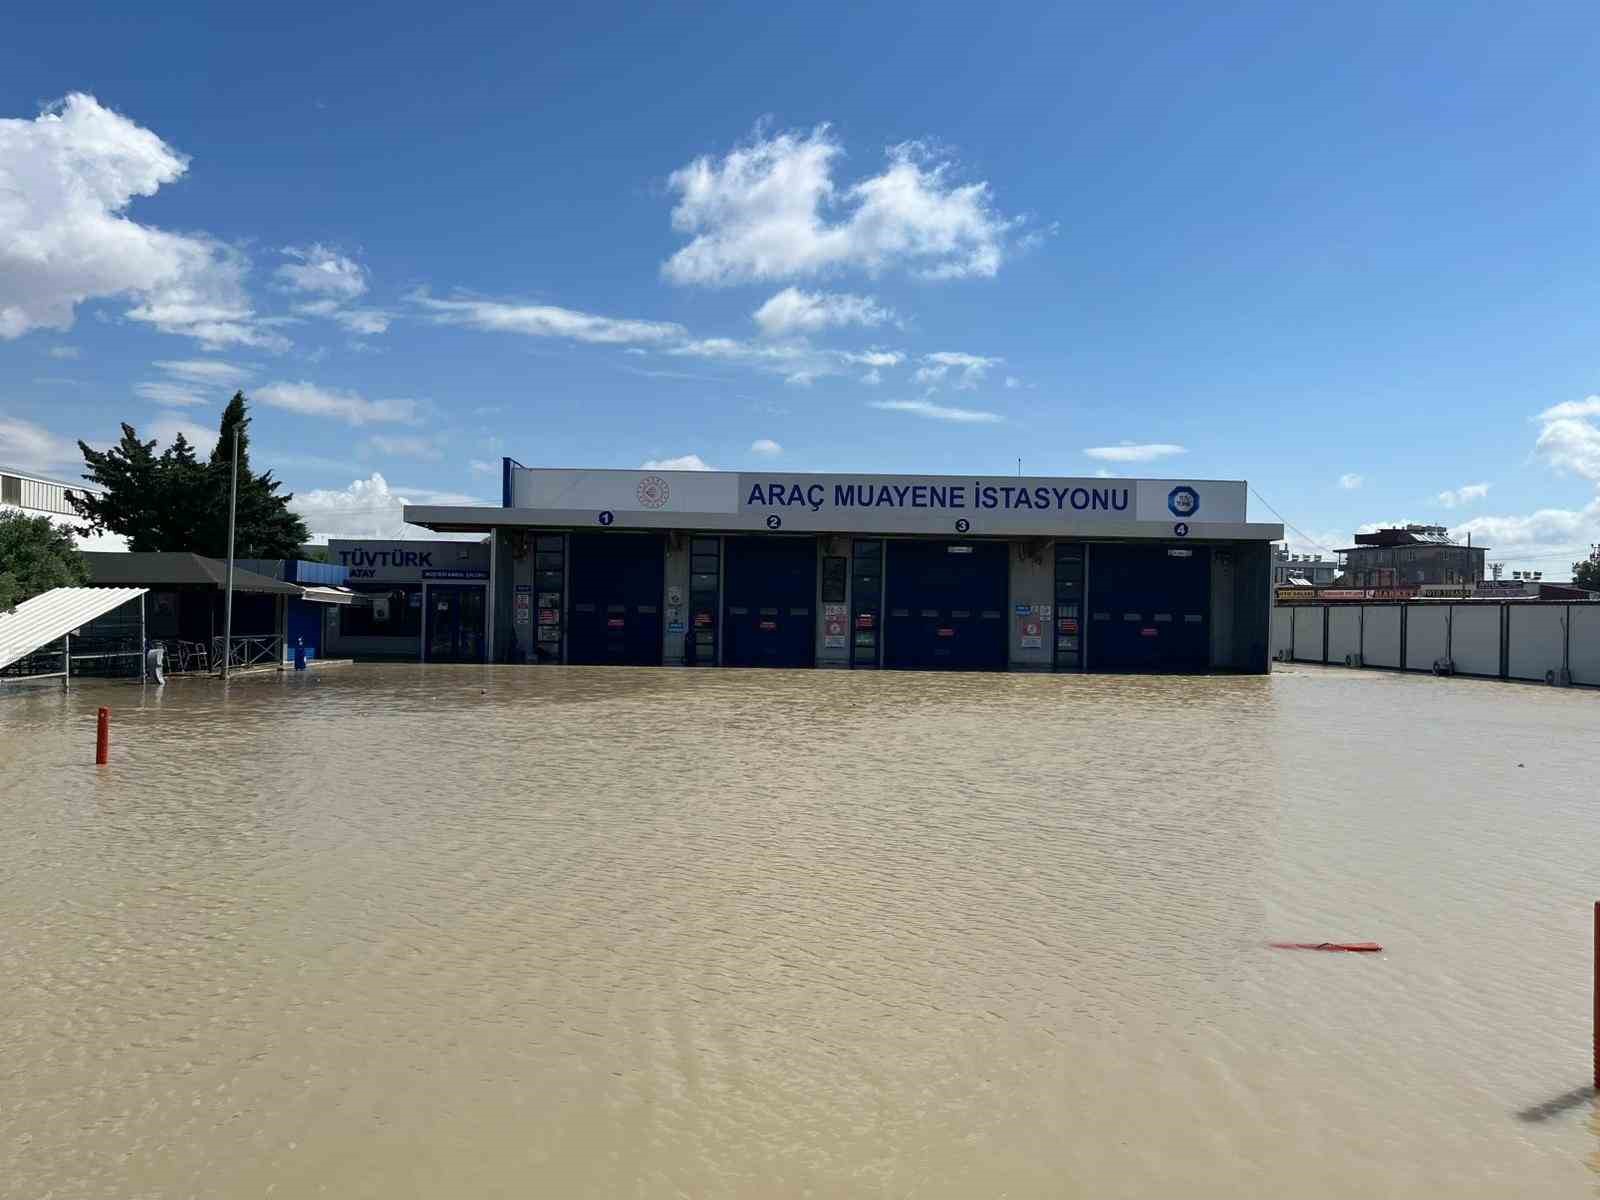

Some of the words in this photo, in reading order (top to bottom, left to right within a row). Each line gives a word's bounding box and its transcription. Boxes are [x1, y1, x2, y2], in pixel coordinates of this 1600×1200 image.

[748, 483, 825, 512] ARAÇ
[834, 484, 965, 508] MUAYENE
[974, 481, 1129, 511] İSTASYONU
[338, 547, 433, 567] TÜVTÜRK
